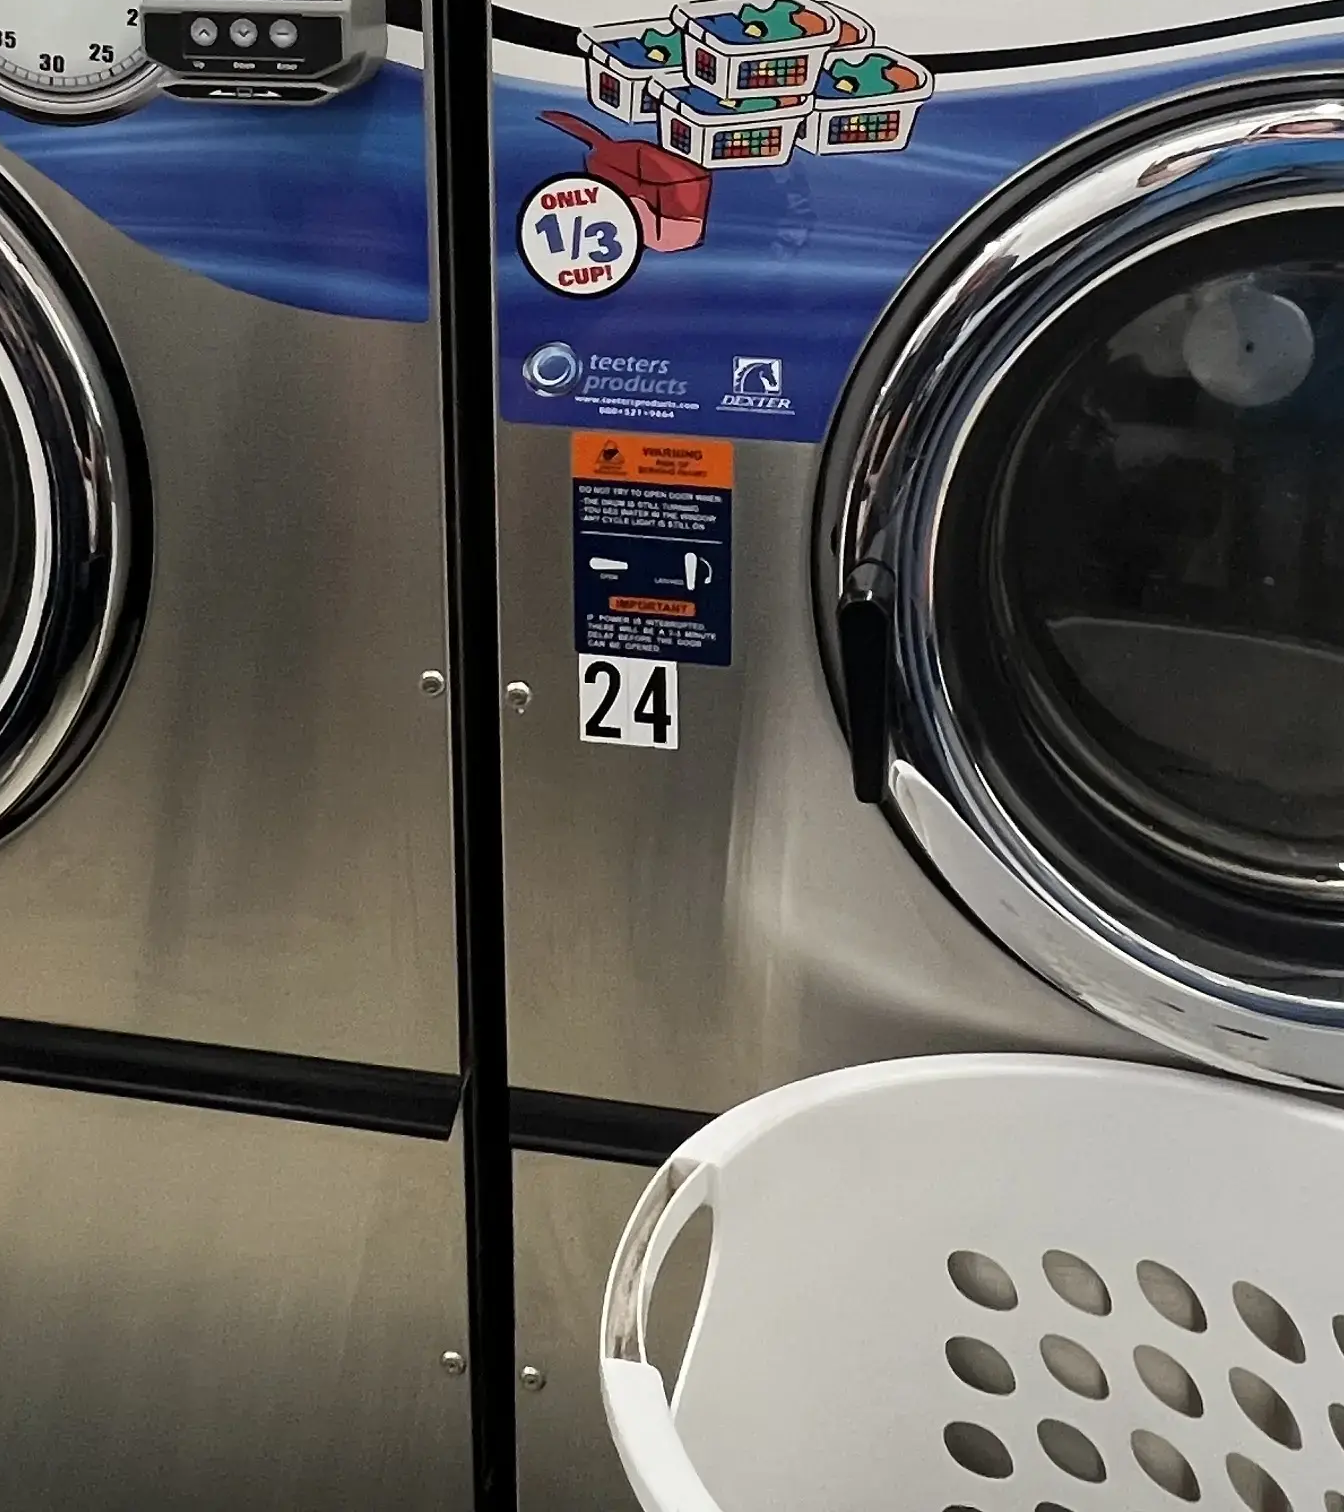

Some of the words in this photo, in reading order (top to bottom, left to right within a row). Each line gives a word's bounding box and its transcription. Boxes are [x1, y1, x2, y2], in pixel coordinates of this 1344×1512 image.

[126, 8, 139, 27] 2
[39, 53, 65, 74] 30
[88, 43, 114, 64] 25
[540, 187, 599, 210] ONLY
[534, 213, 623, 263] 1/3
[557, 264, 613, 287] CUP!
[589, 354, 671, 375] teeters
[583, 373, 687, 395] products
[721, 394, 791, 408] DEXTER
[642, 447, 703, 461] WARNING
[615, 599, 688, 614] IMPORTANT
[584, 660, 672, 744] 24
